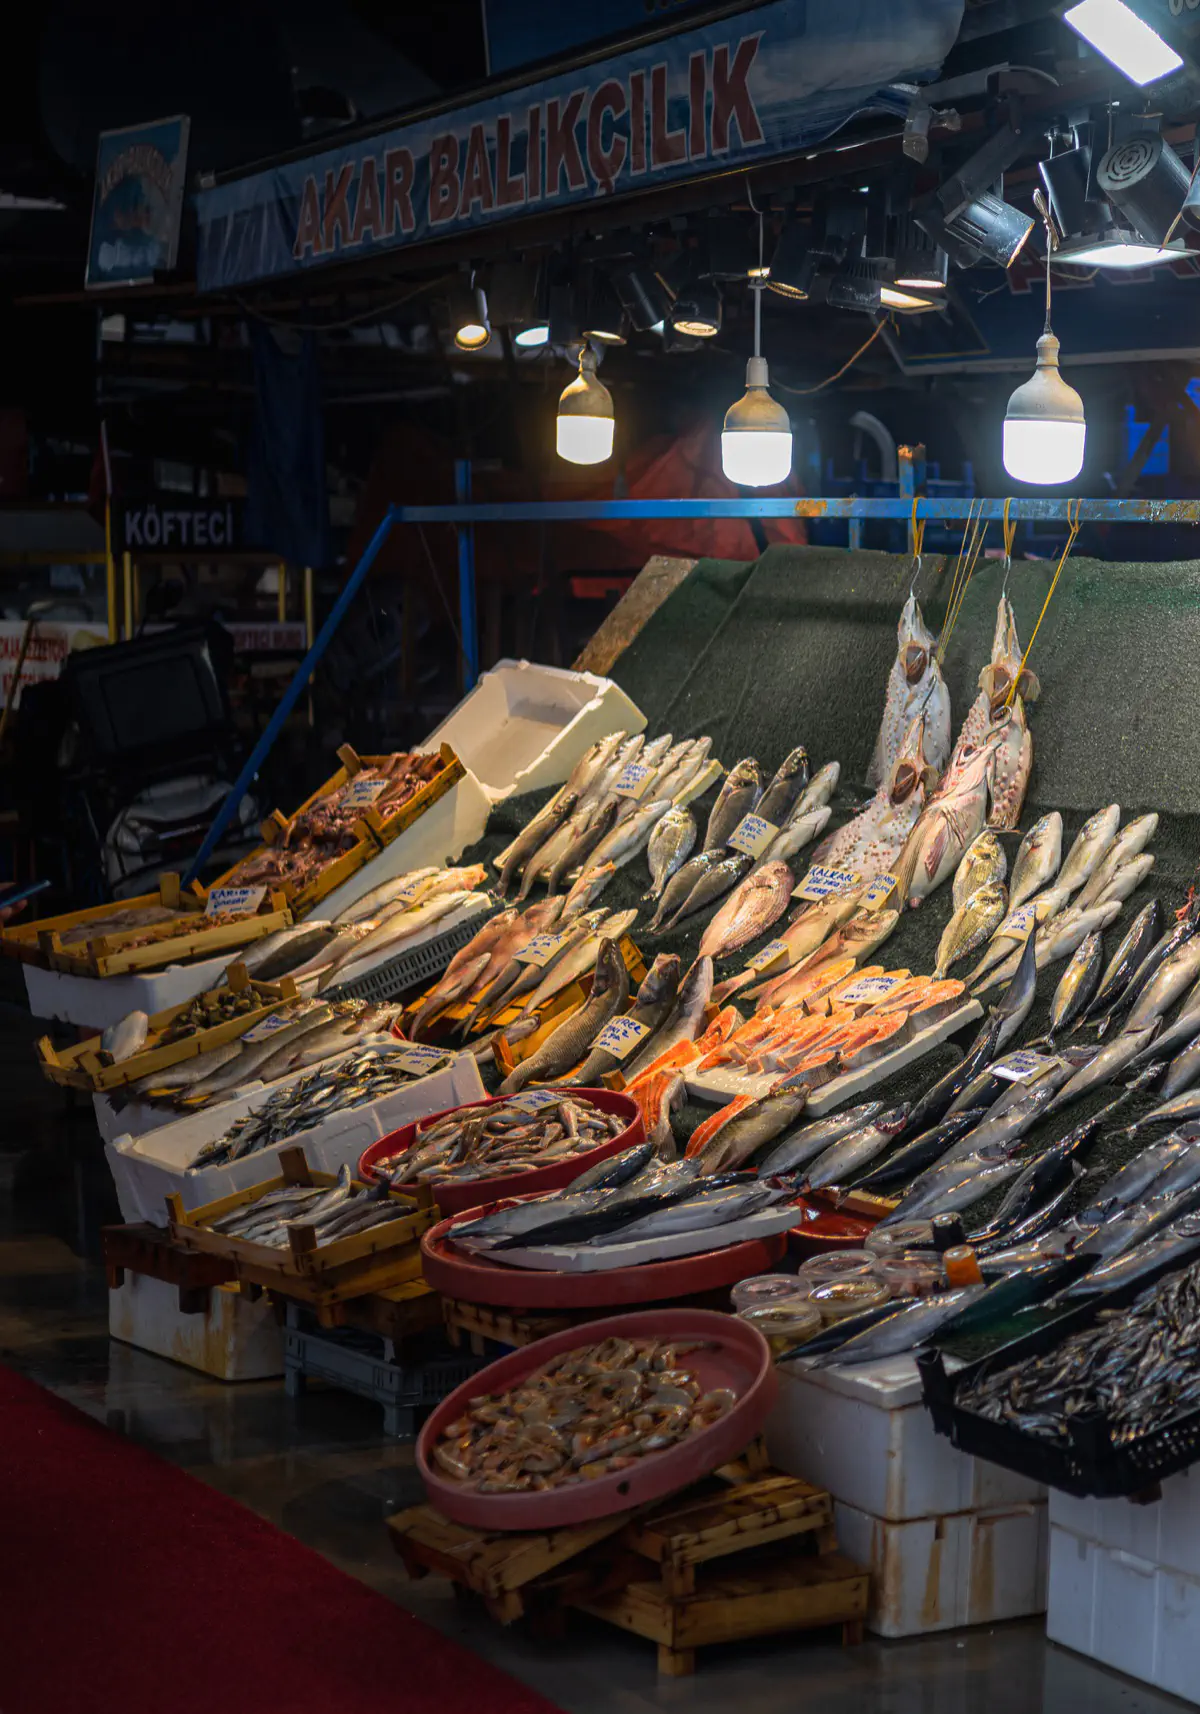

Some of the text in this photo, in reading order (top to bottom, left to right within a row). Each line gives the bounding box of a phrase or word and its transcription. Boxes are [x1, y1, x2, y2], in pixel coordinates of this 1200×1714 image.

[293, 30, 767, 260] AKAR BALIKÇILIK
[125, 502, 233, 546] KÖFTECİ
[810, 866, 855, 882] KALKAN
